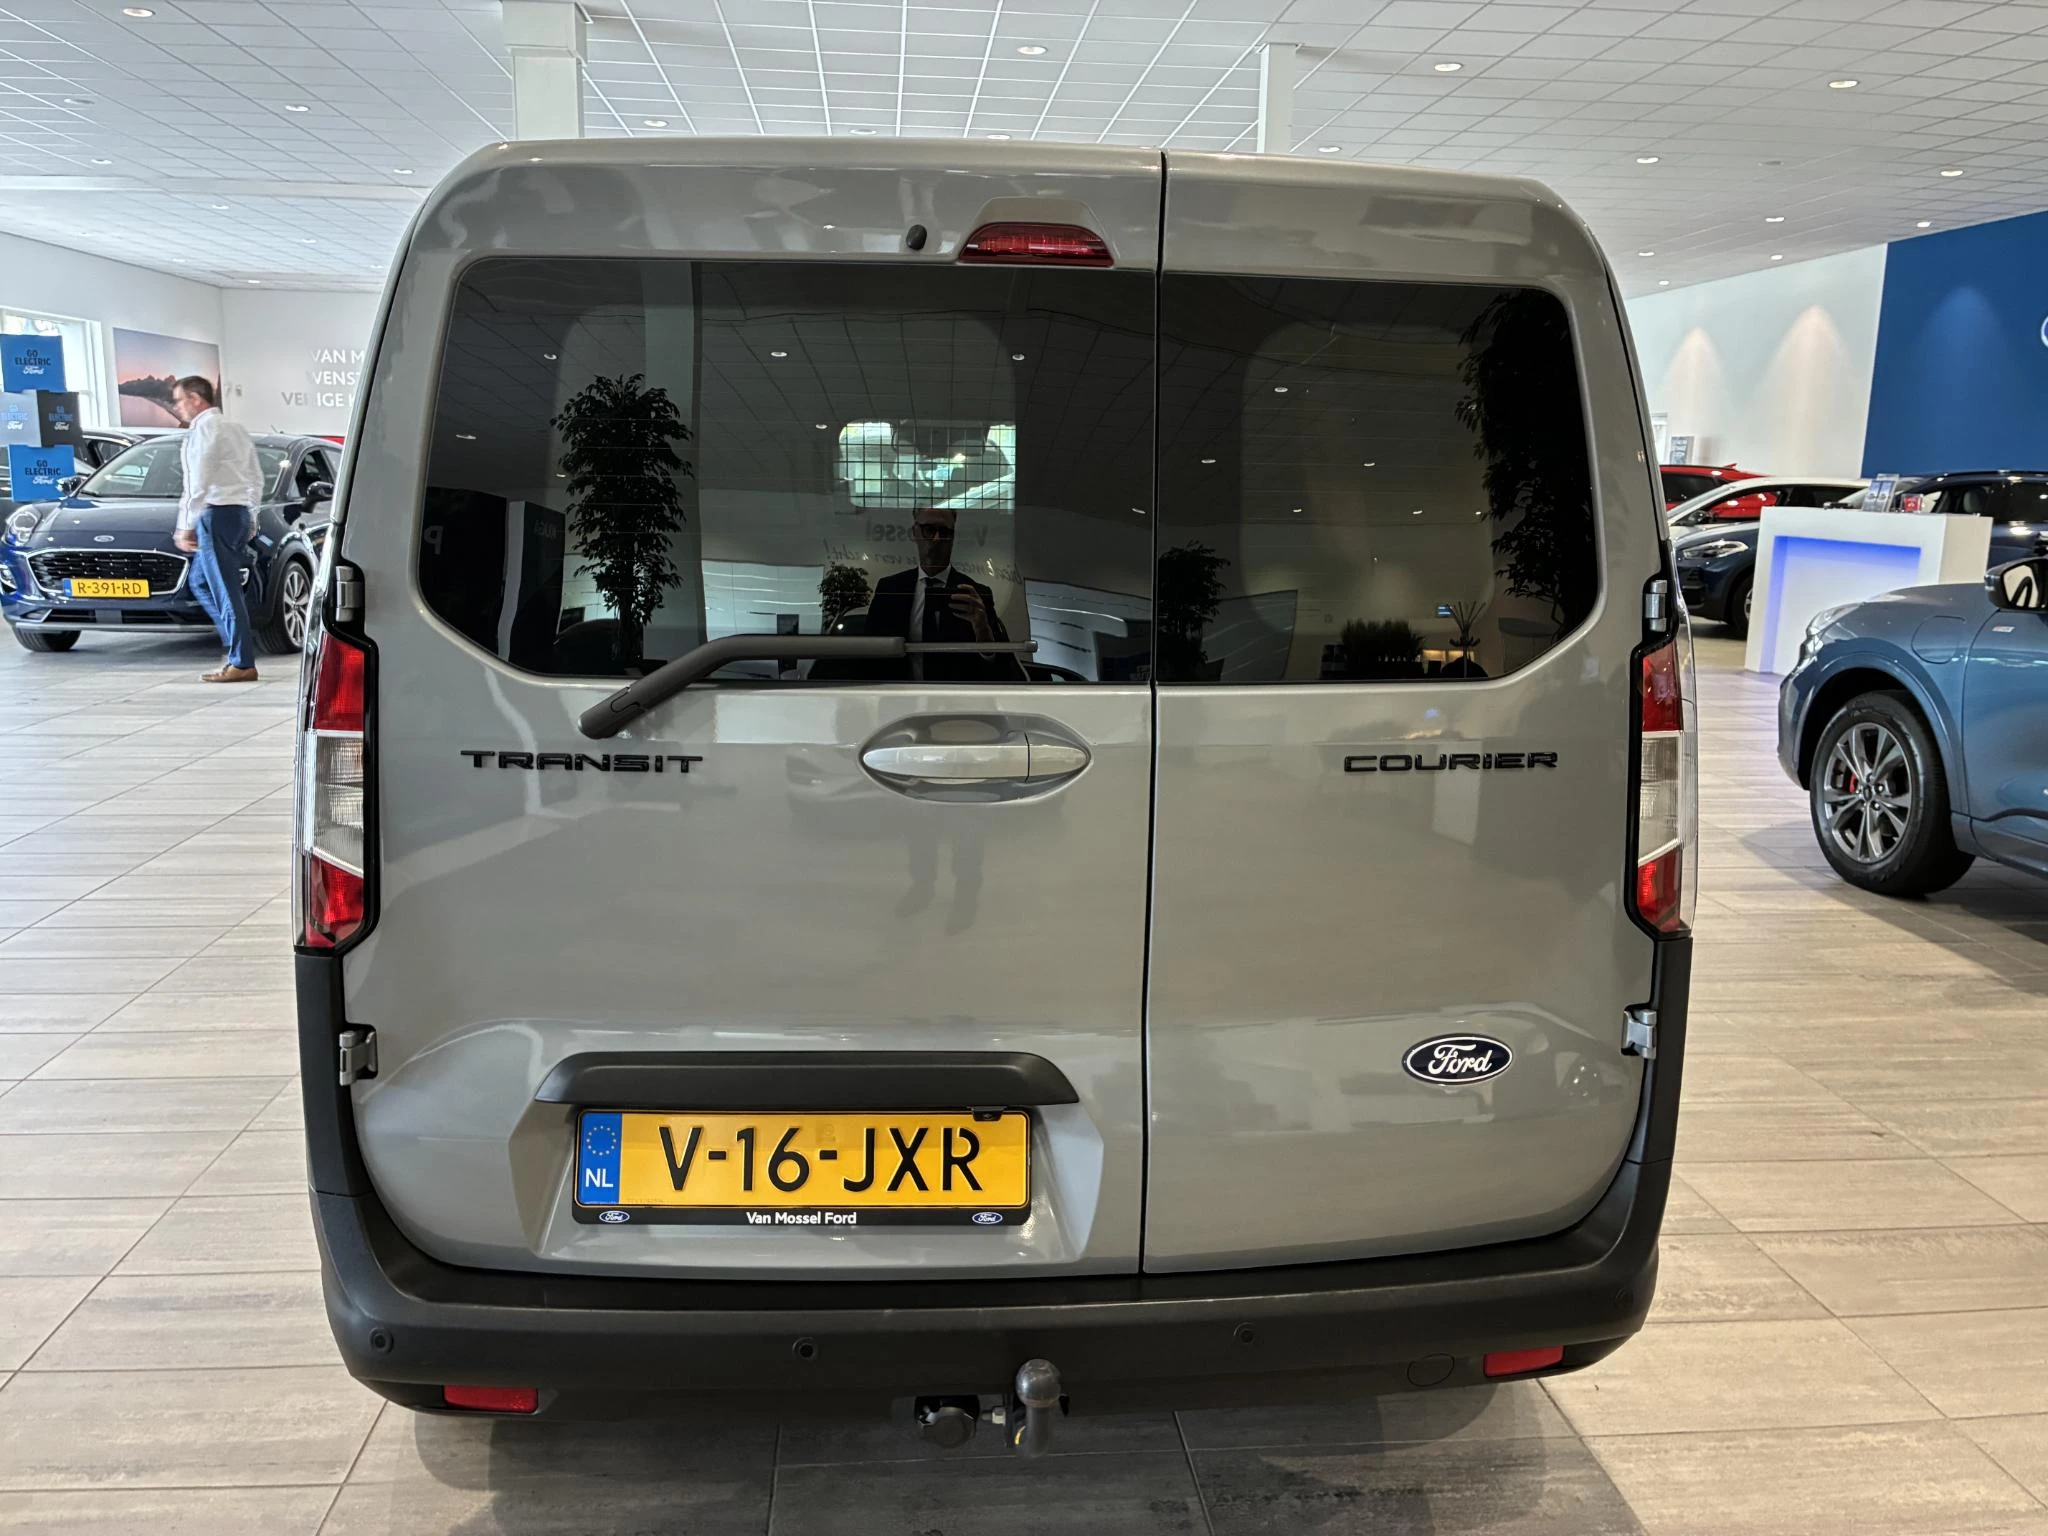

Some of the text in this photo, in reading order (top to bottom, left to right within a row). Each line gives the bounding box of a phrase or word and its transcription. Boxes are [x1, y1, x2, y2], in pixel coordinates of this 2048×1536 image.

[26, 349, 38, 358] GO
[312, 349, 346, 364] VAN
[14, 357, 52, 366] ELECTRIC
[23, 365, 45, 375] Ford
[36, 459, 48, 468] GO
[24, 467, 61, 476] ELECTRIC
[32, 475, 55, 485] Ford
[77, 582, 142, 595] R-391-RD
[460, 750, 703, 773] TRANSIT
[1344, 752, 1558, 773] COURIER
[1427, 1043, 1493, 1075] Ford
[659, 1125, 984, 1193] V-16-JXR
[585, 1168, 614, 1188] NL
[746, 1211, 857, 1225] Van Mossel Ford
